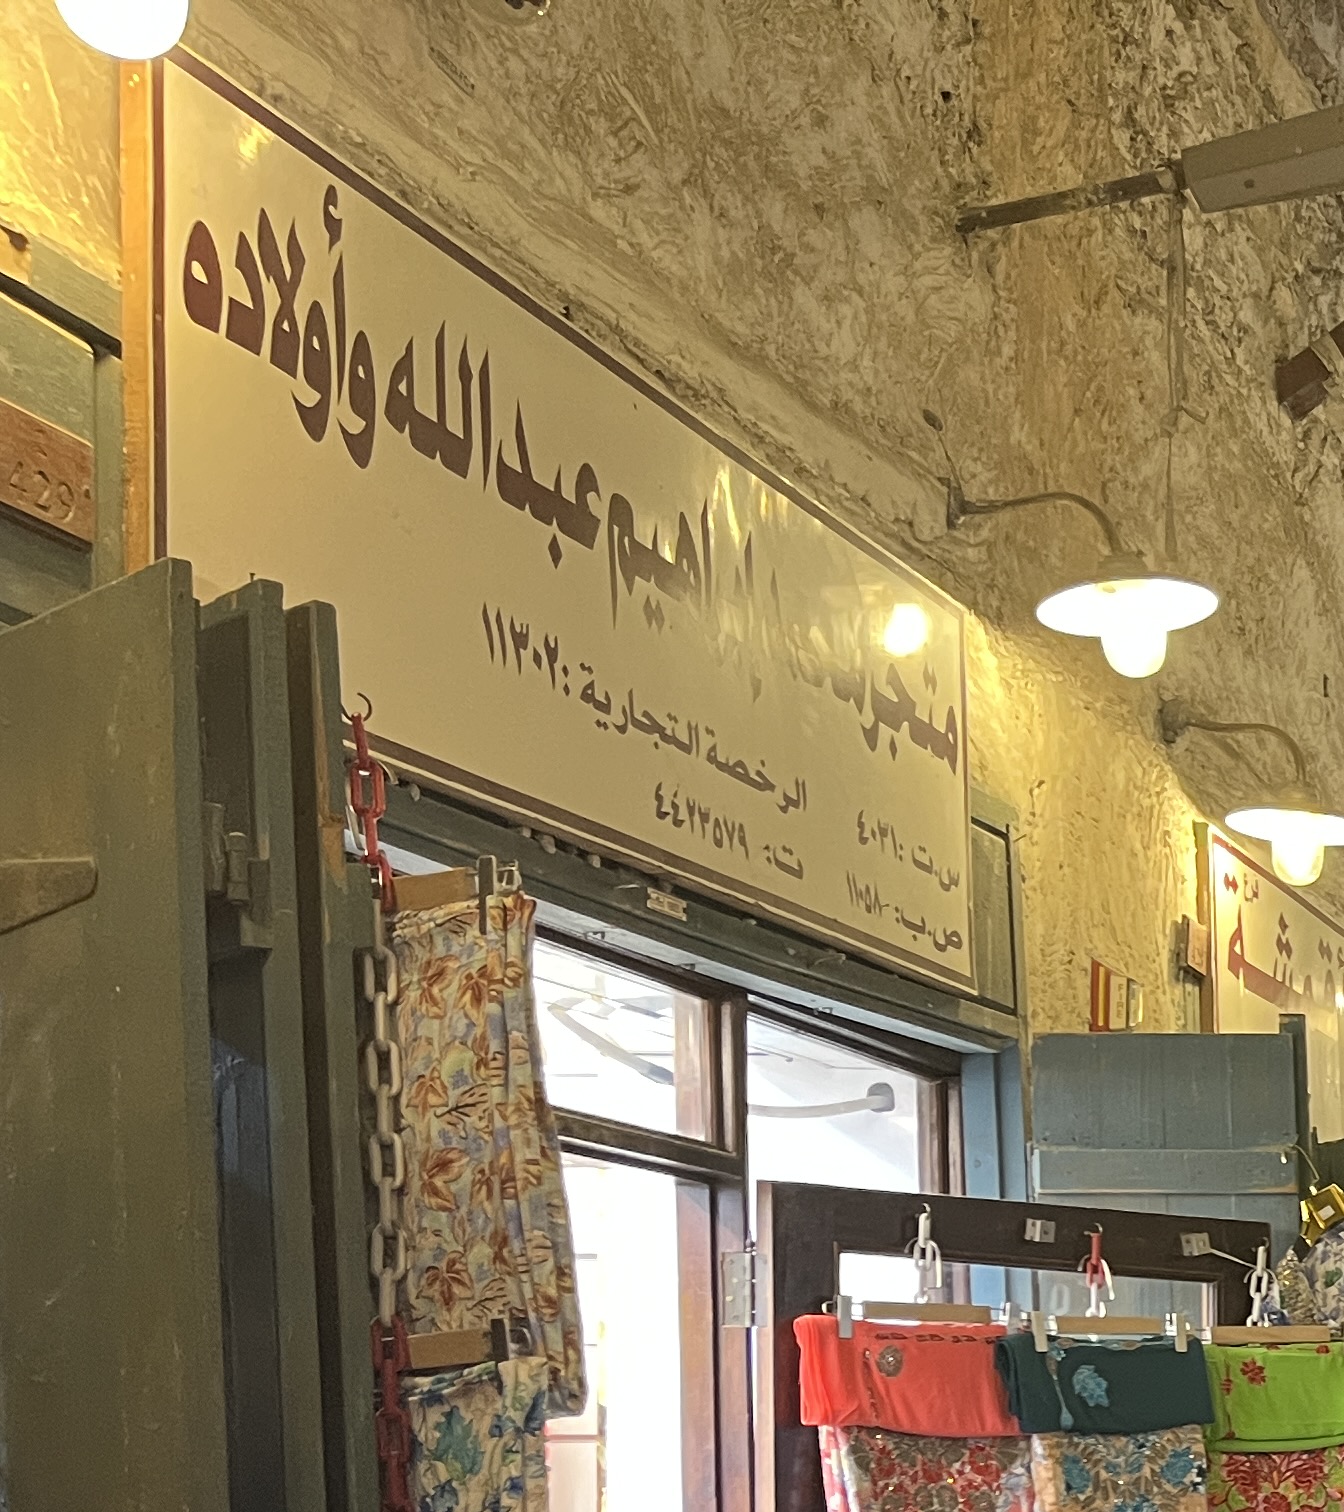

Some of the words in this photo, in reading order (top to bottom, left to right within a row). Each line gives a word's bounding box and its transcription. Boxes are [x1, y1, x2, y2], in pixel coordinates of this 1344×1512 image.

[184, 183, 376, 470] وأولاده
[860, 659, 959, 776] متجر
[705, 725, 808, 815] الرخصة
[1116, 983, 1124, 1020] FIRE
